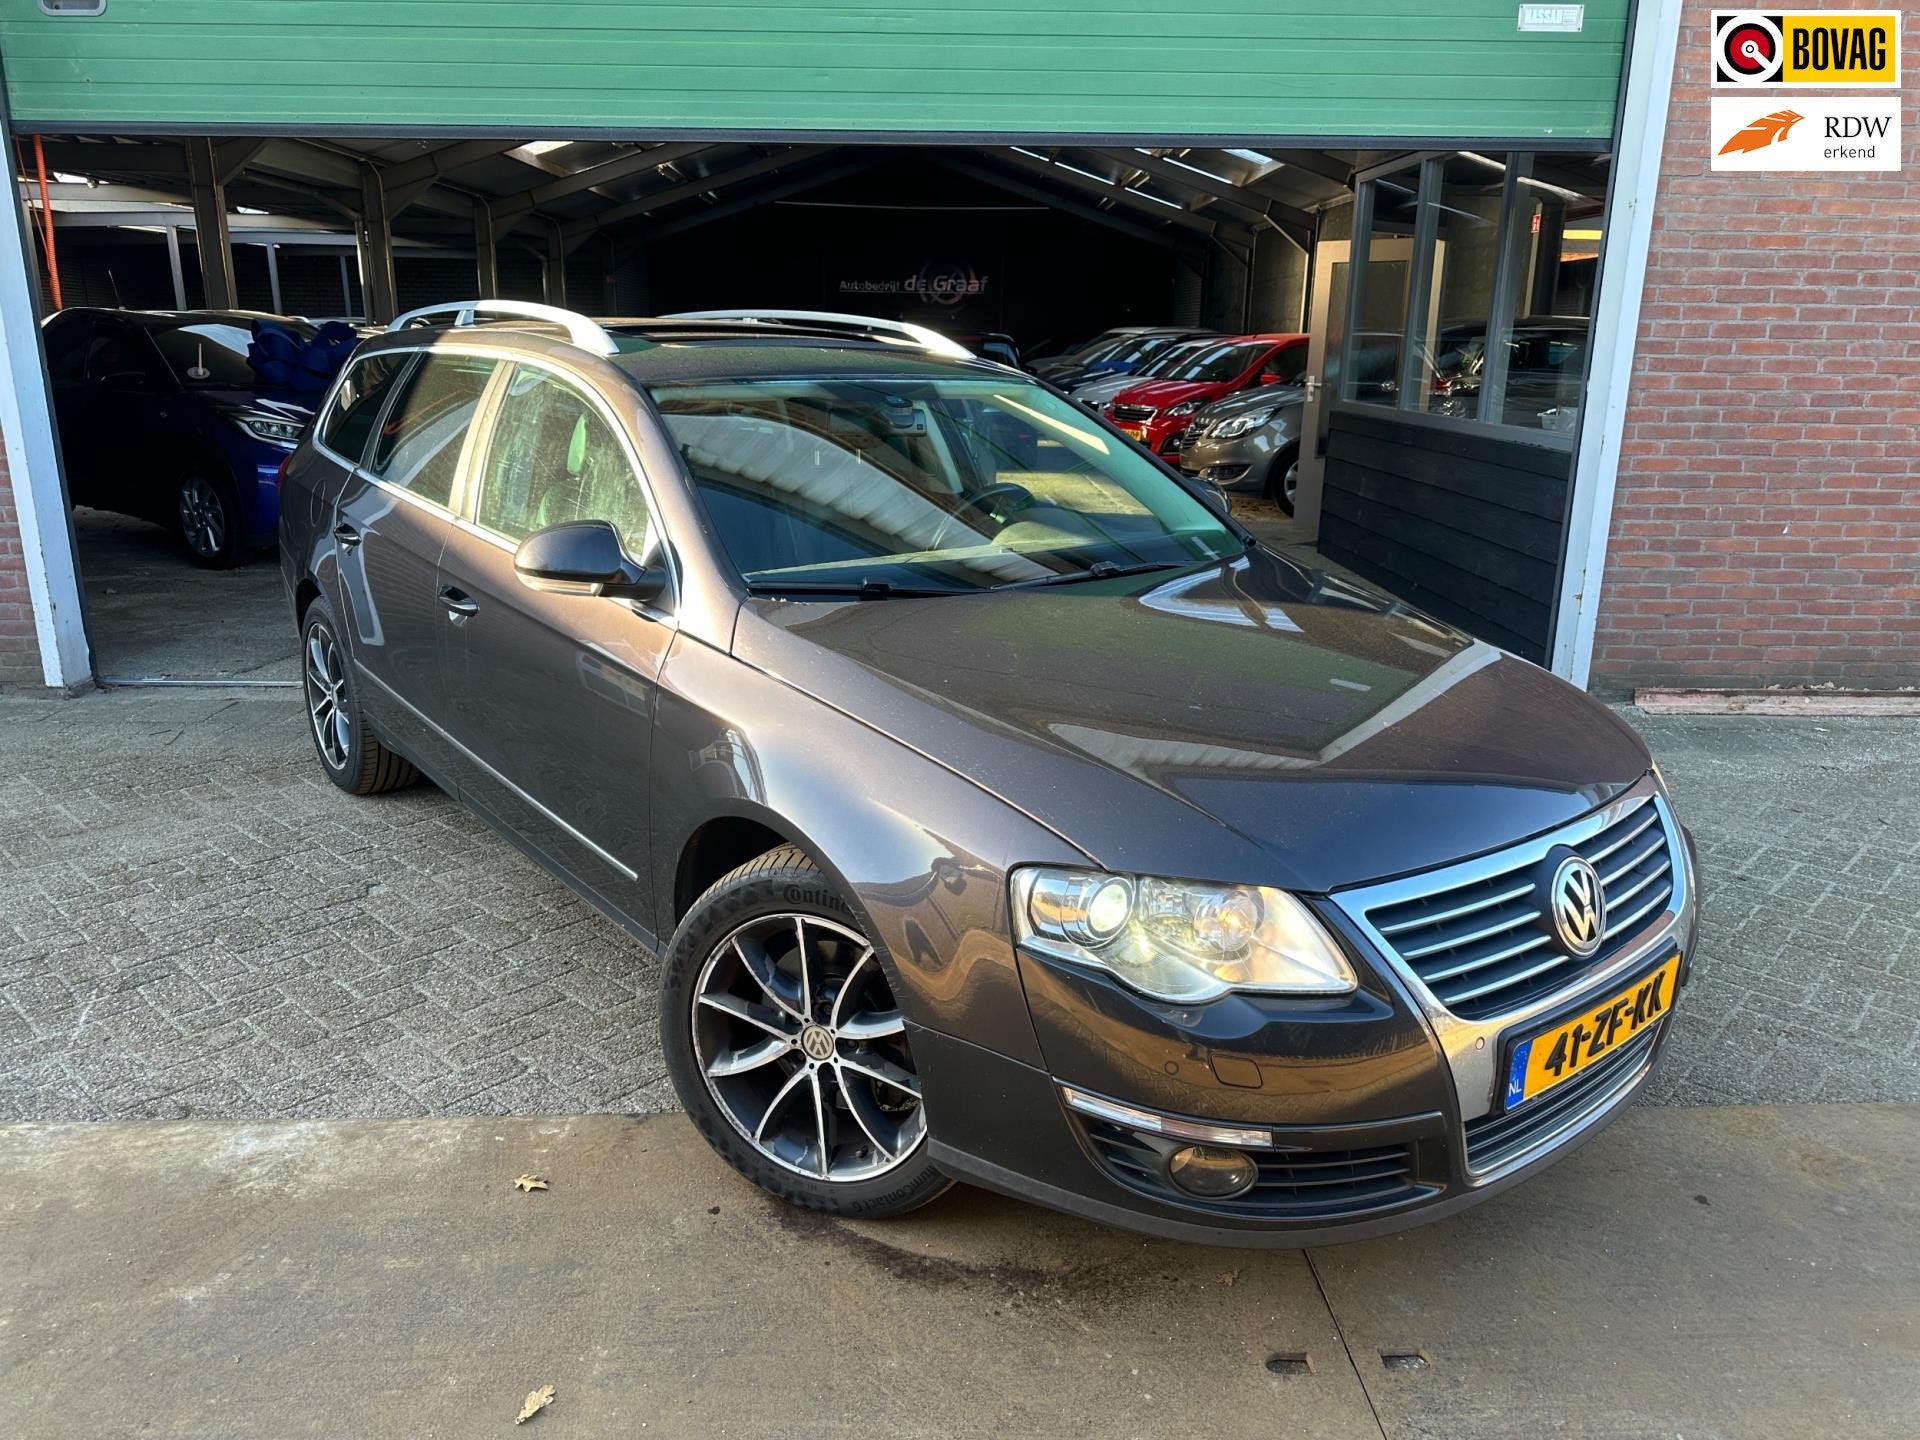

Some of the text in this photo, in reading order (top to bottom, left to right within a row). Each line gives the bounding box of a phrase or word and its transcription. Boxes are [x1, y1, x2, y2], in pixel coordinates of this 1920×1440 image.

[904, 275, 928, 291] de
[932, 275, 989, 292] Graaf
[1544, 969, 1667, 1077] 41-ZF-KK
[1508, 1079, 1522, 1097] NL
